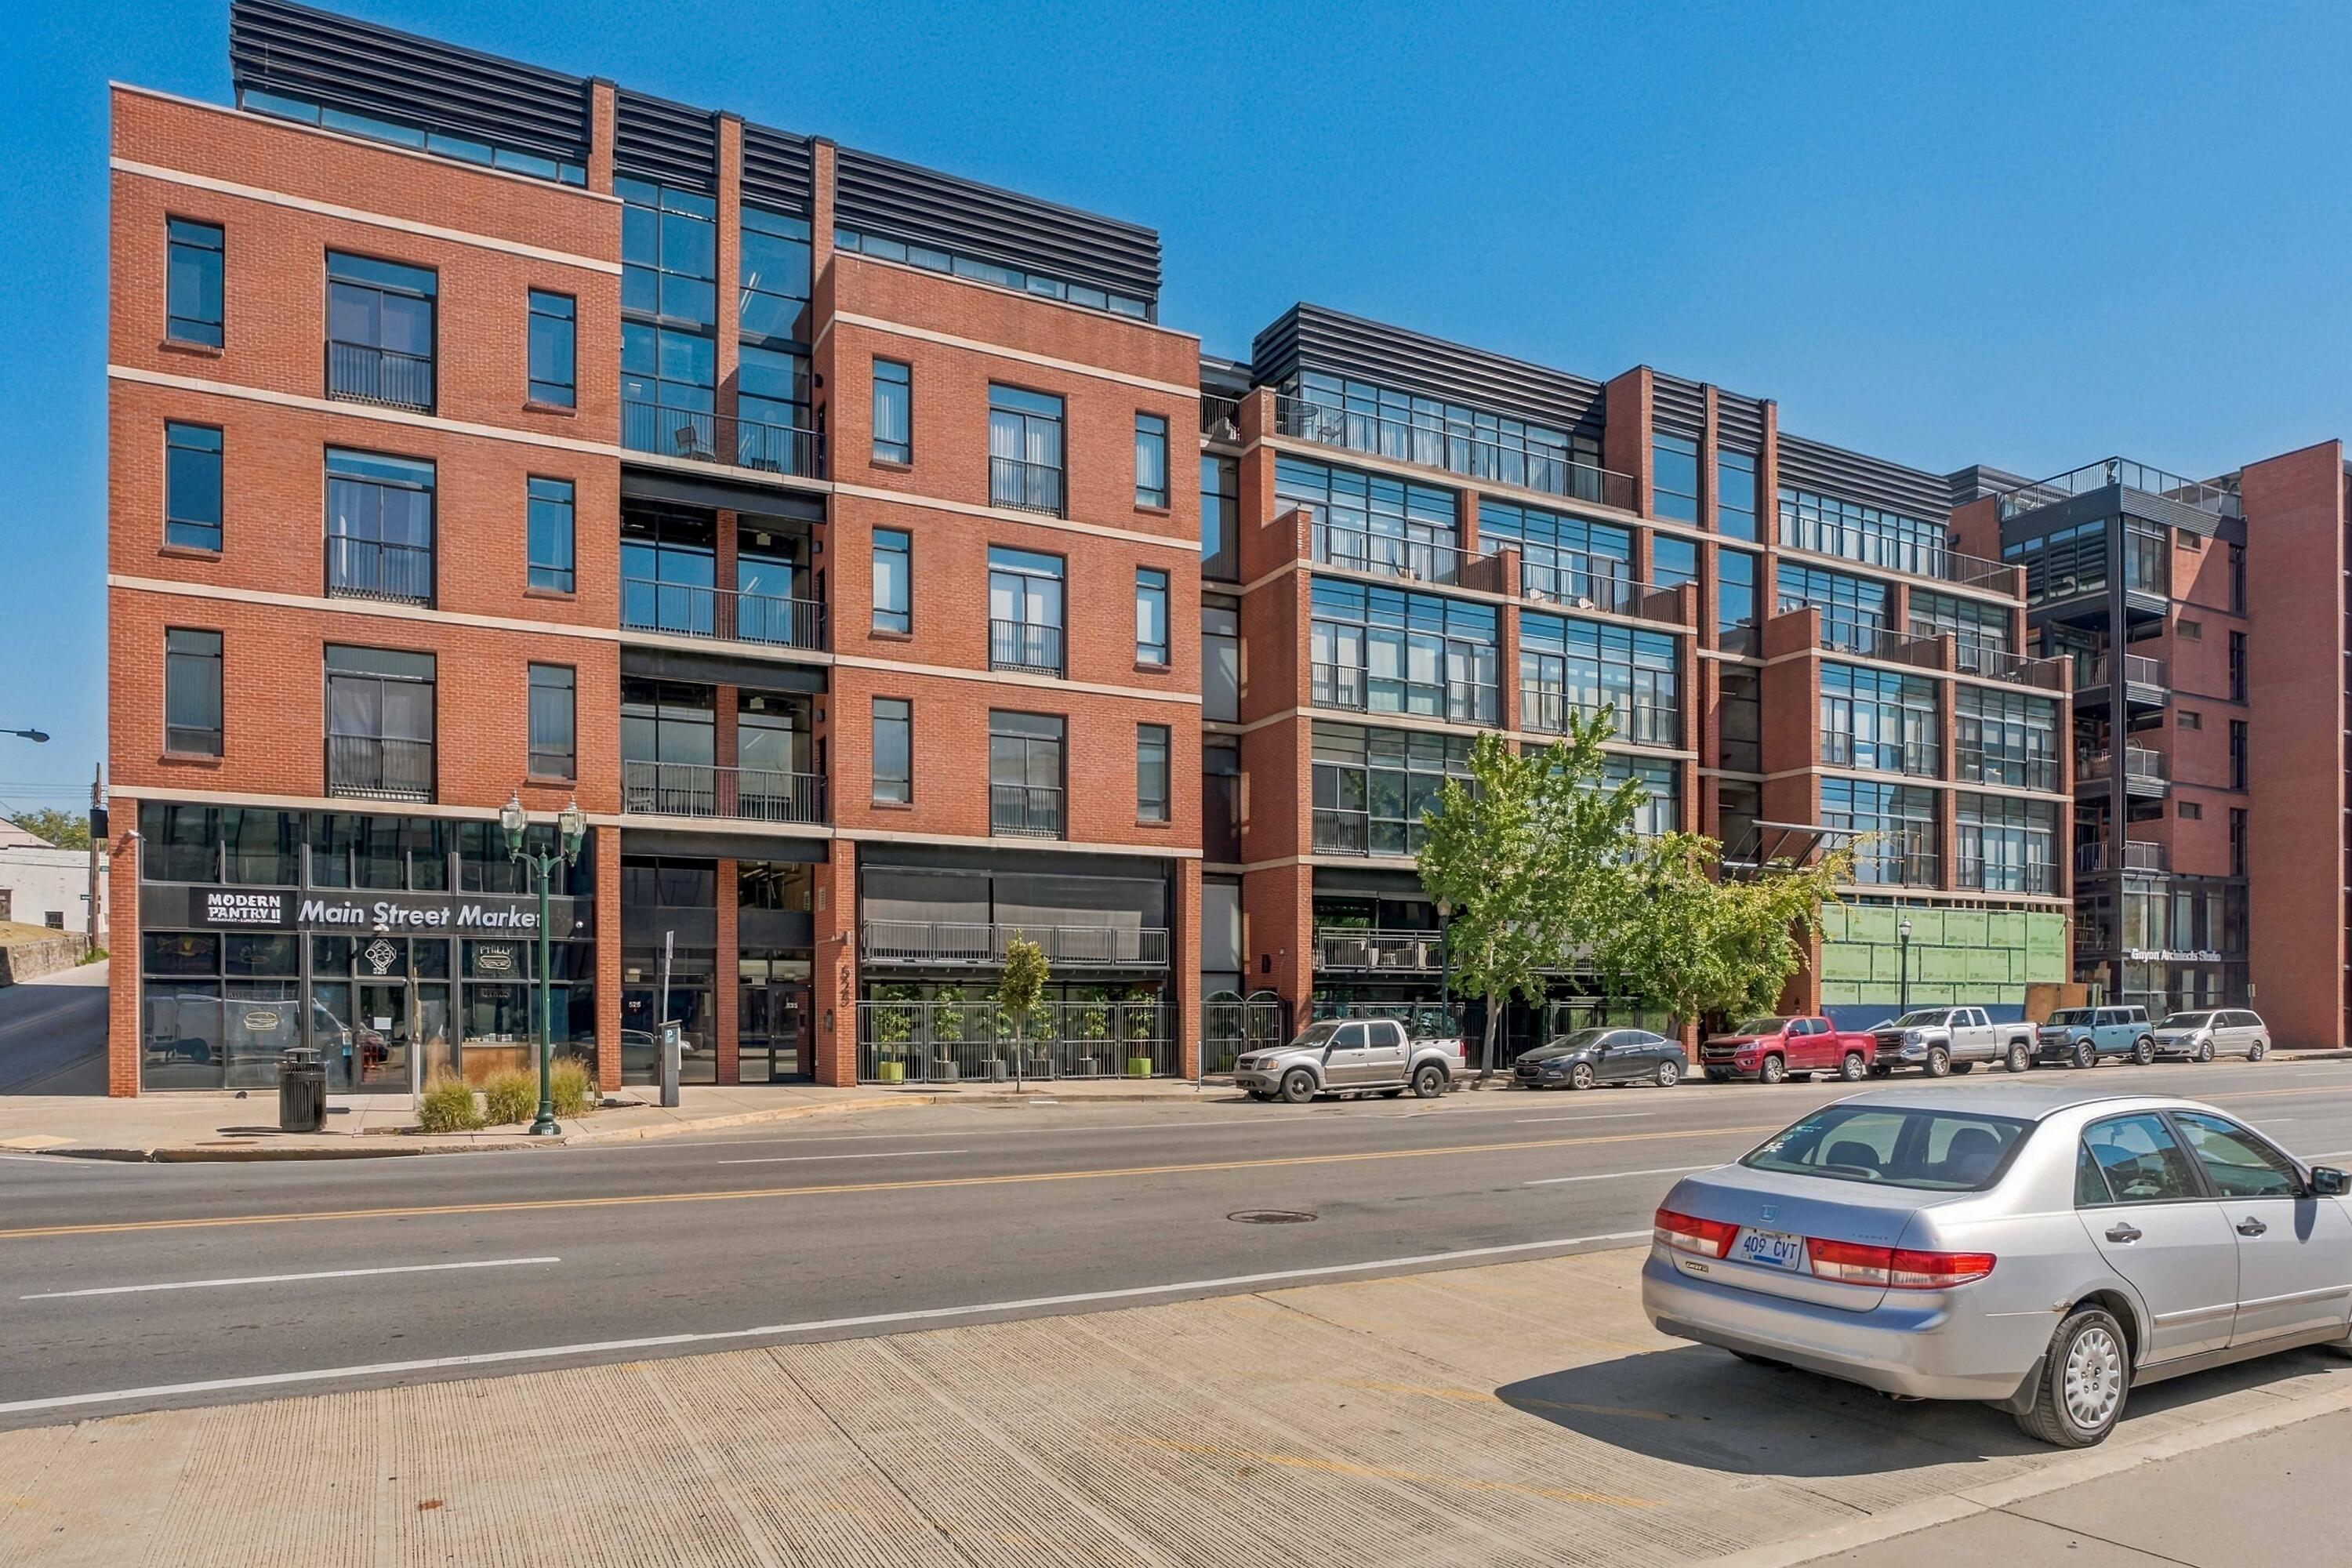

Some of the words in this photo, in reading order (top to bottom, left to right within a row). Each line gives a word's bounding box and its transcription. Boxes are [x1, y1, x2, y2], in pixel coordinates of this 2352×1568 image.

[208, 893, 281, 907] MODERN
[208, 906, 269, 919] PANTRY
[271, 908, 281, 920] II
[298, 900, 365, 923] Main
[372, 902, 450, 925] Street
[365, 949, 397, 959] OPEN
[480, 946, 513, 955] PHILLY
[1744, 1235, 1766, 1253] 409
[1773, 1241, 1798, 1259] CVT
